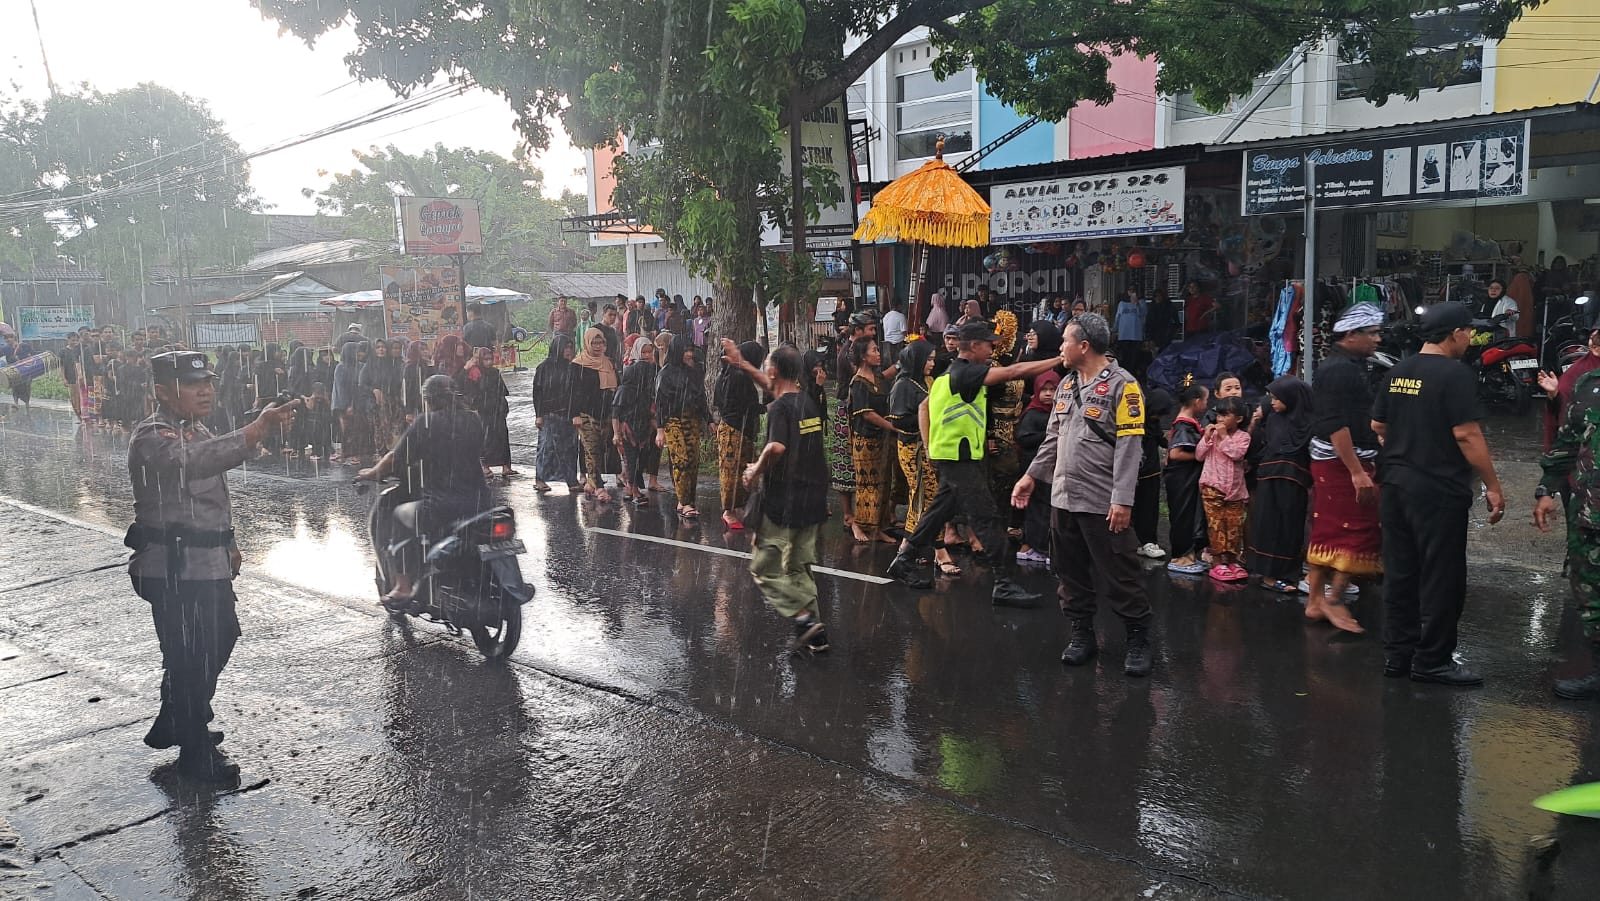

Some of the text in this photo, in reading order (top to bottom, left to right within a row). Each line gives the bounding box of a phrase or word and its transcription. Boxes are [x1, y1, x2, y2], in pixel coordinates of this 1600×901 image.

[800, 145, 833, 164] STRIK
[1252, 154, 1300, 174] Bunga
[1004, 173, 1170, 199] ALVIN TOYS 924
[961, 268, 1071, 300] propan
